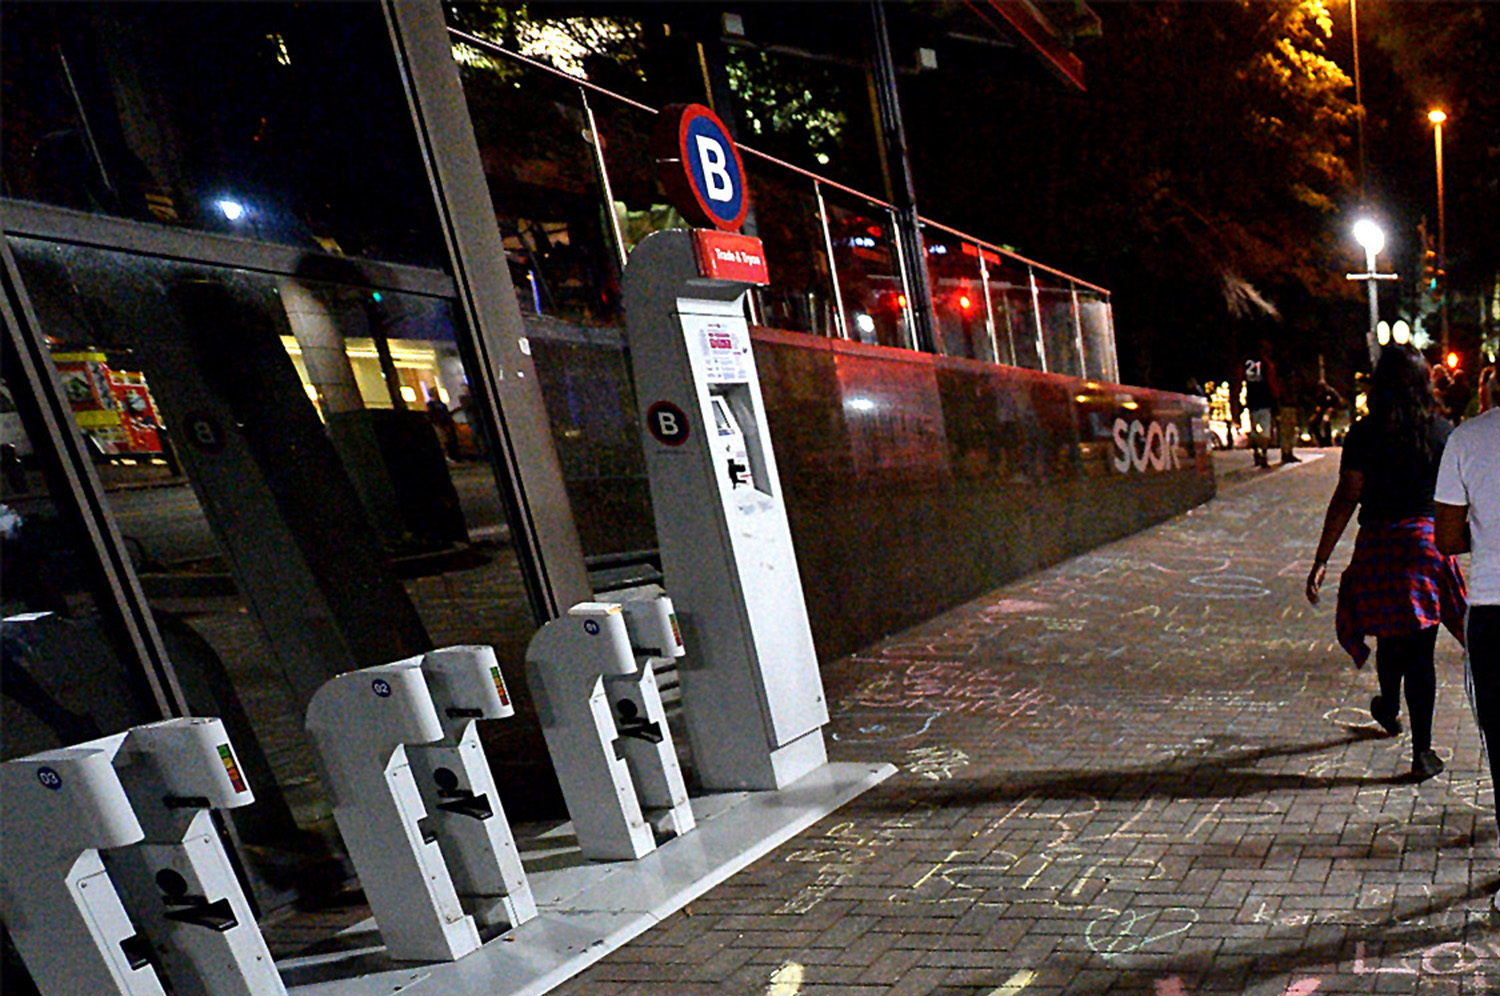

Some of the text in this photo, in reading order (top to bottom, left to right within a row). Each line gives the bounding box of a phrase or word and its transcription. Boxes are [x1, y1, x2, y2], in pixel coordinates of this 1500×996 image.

[695, 134, 734, 203] B
[1245, 359, 1262, 376] 21
[657, 411, 679, 435] B
[373, 680, 391, 697] 02
[40, 772, 59, 785] 03
